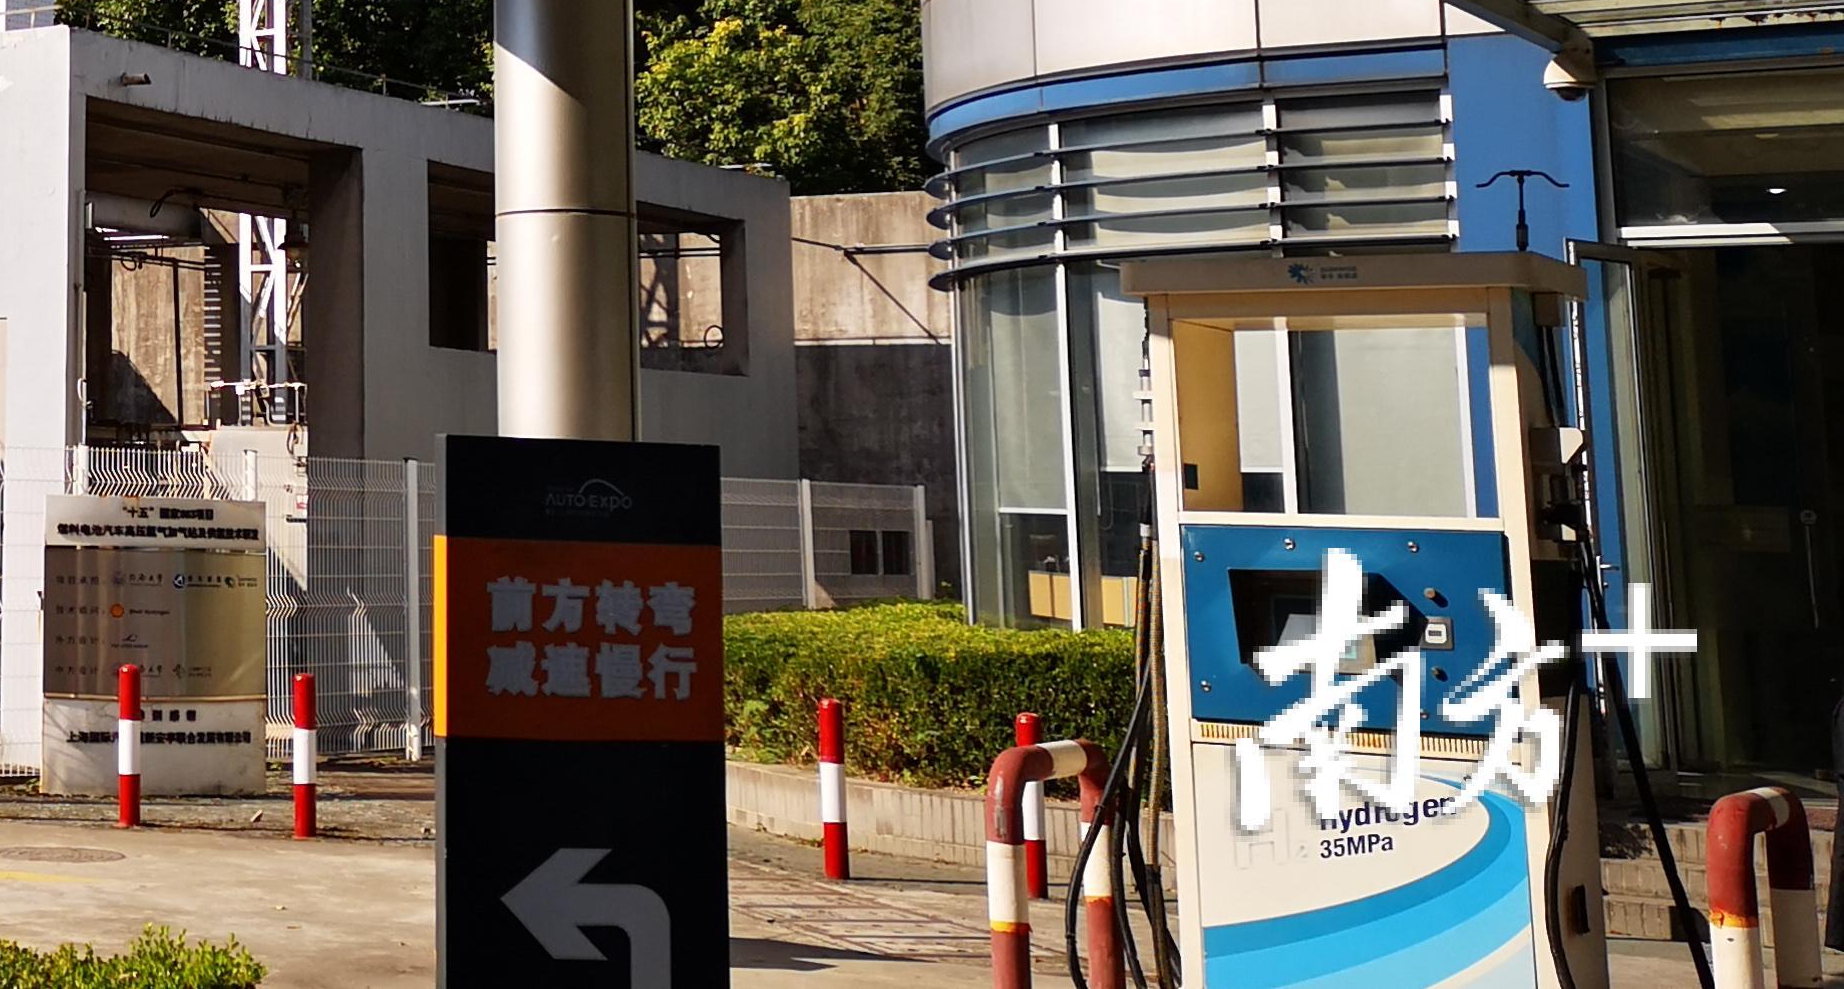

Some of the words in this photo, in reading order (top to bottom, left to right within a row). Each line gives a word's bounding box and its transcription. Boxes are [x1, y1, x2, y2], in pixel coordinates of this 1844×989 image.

[487, 576, 696, 636] 前方转弯
[486, 640, 698, 701] 减速慢行
[1320, 834, 1393, 859] 35MPa
